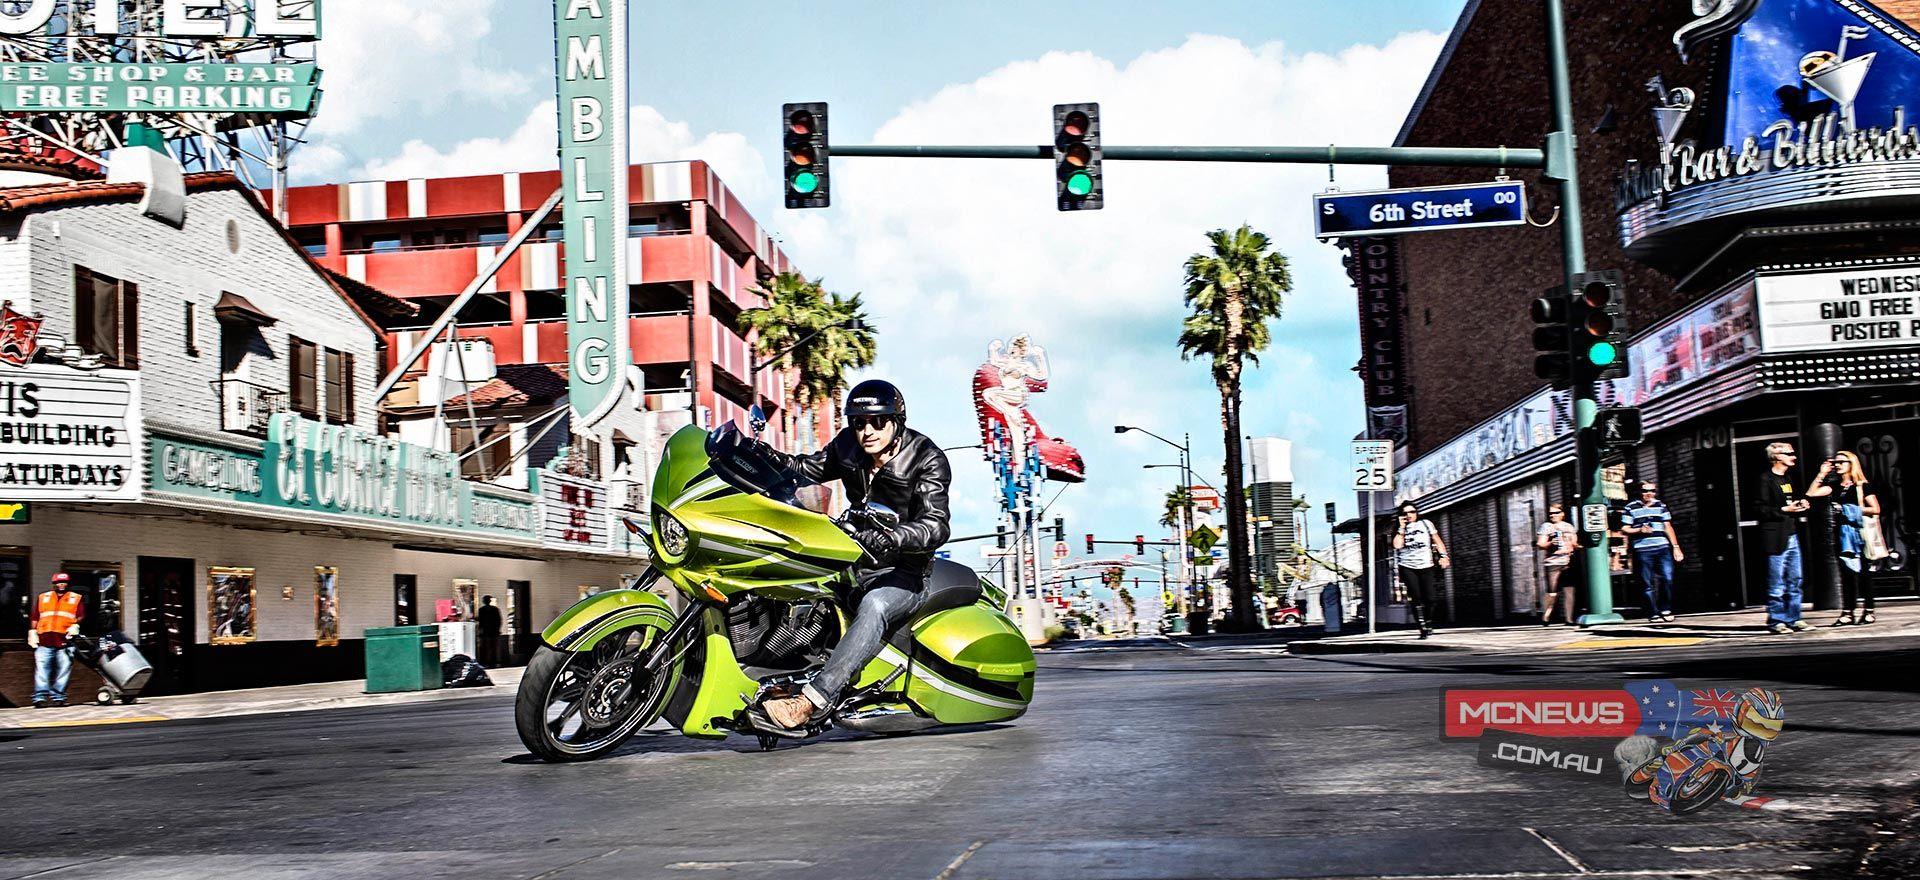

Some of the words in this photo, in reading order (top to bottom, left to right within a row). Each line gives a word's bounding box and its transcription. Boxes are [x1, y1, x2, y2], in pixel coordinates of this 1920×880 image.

[68, 66, 168, 82] SHOP
[184, 66, 205, 82] &
[224, 66, 296, 83] BAR
[16, 85, 108, 107] FREE
[127, 86, 292, 109] PARKING
[1672, 138, 1732, 186] Bar
[1736, 135, 1765, 176] &
[1323, 203, 1335, 215] S
[1369, 203, 1405, 223] 6th
[1411, 198, 1473, 221] Street
[1367, 237, 1391, 328] OUNTRY
[1870, 298, 1913, 316] FREE
[1831, 321, 1900, 341] POSTER
[1373, 340, 1395, 396] CLUB
[0, 382, 39, 418] IS
[1, 422, 115, 447] BUILDING
[3, 462, 122, 486] ATURDAYS
[1356, 468, 1387, 485] 25
